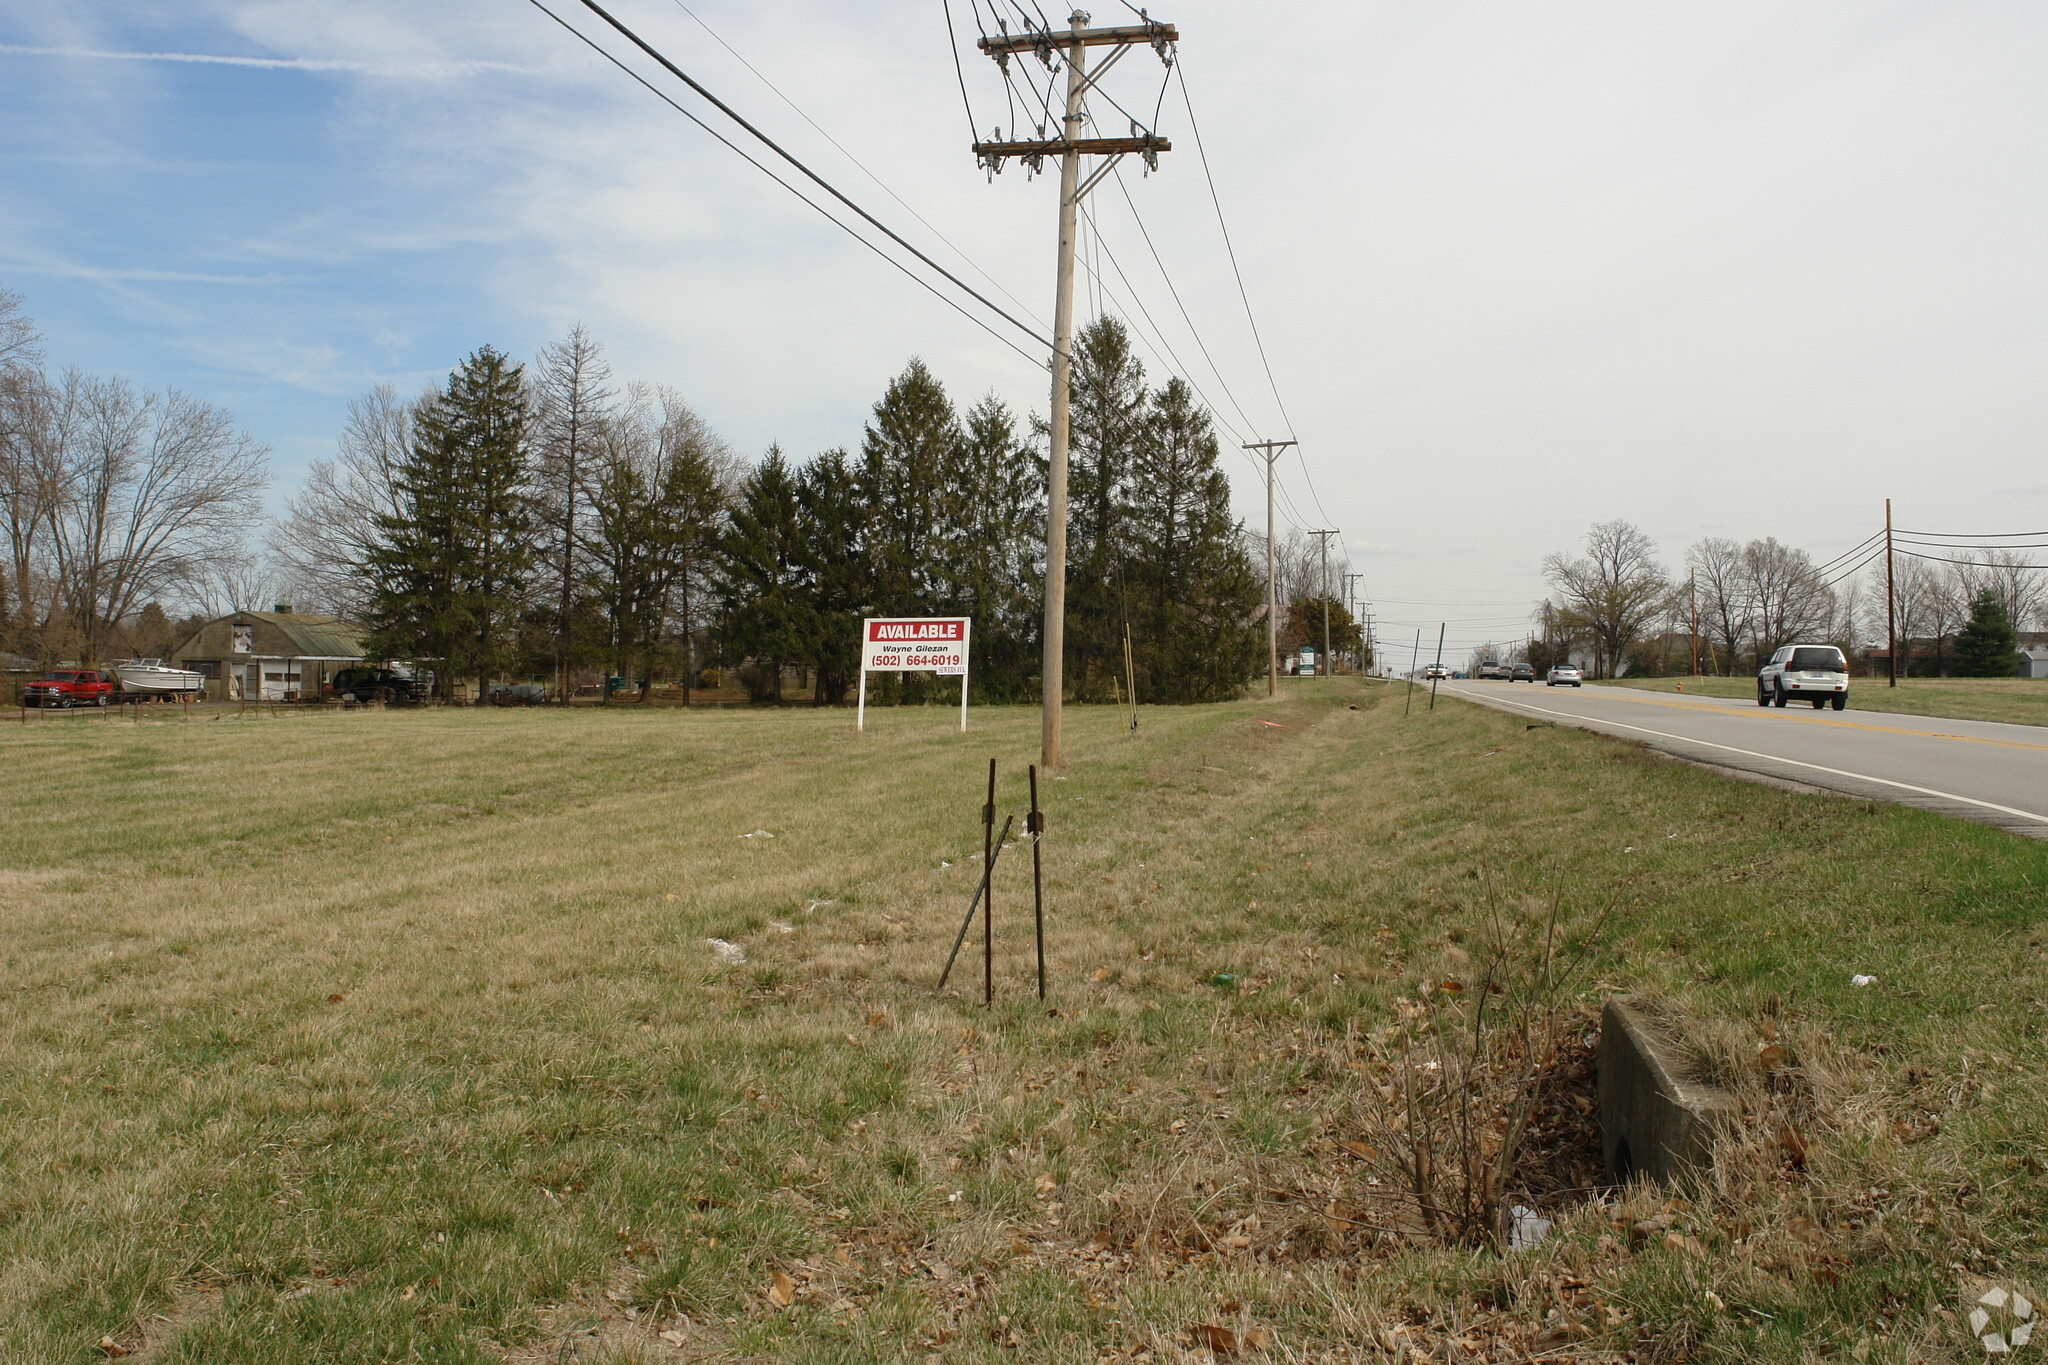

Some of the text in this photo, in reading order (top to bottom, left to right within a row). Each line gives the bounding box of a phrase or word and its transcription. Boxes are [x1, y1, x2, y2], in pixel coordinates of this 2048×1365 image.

[877, 625, 956, 638] AVAILABLE
[872, 655, 960, 667] (502) 664-6019
